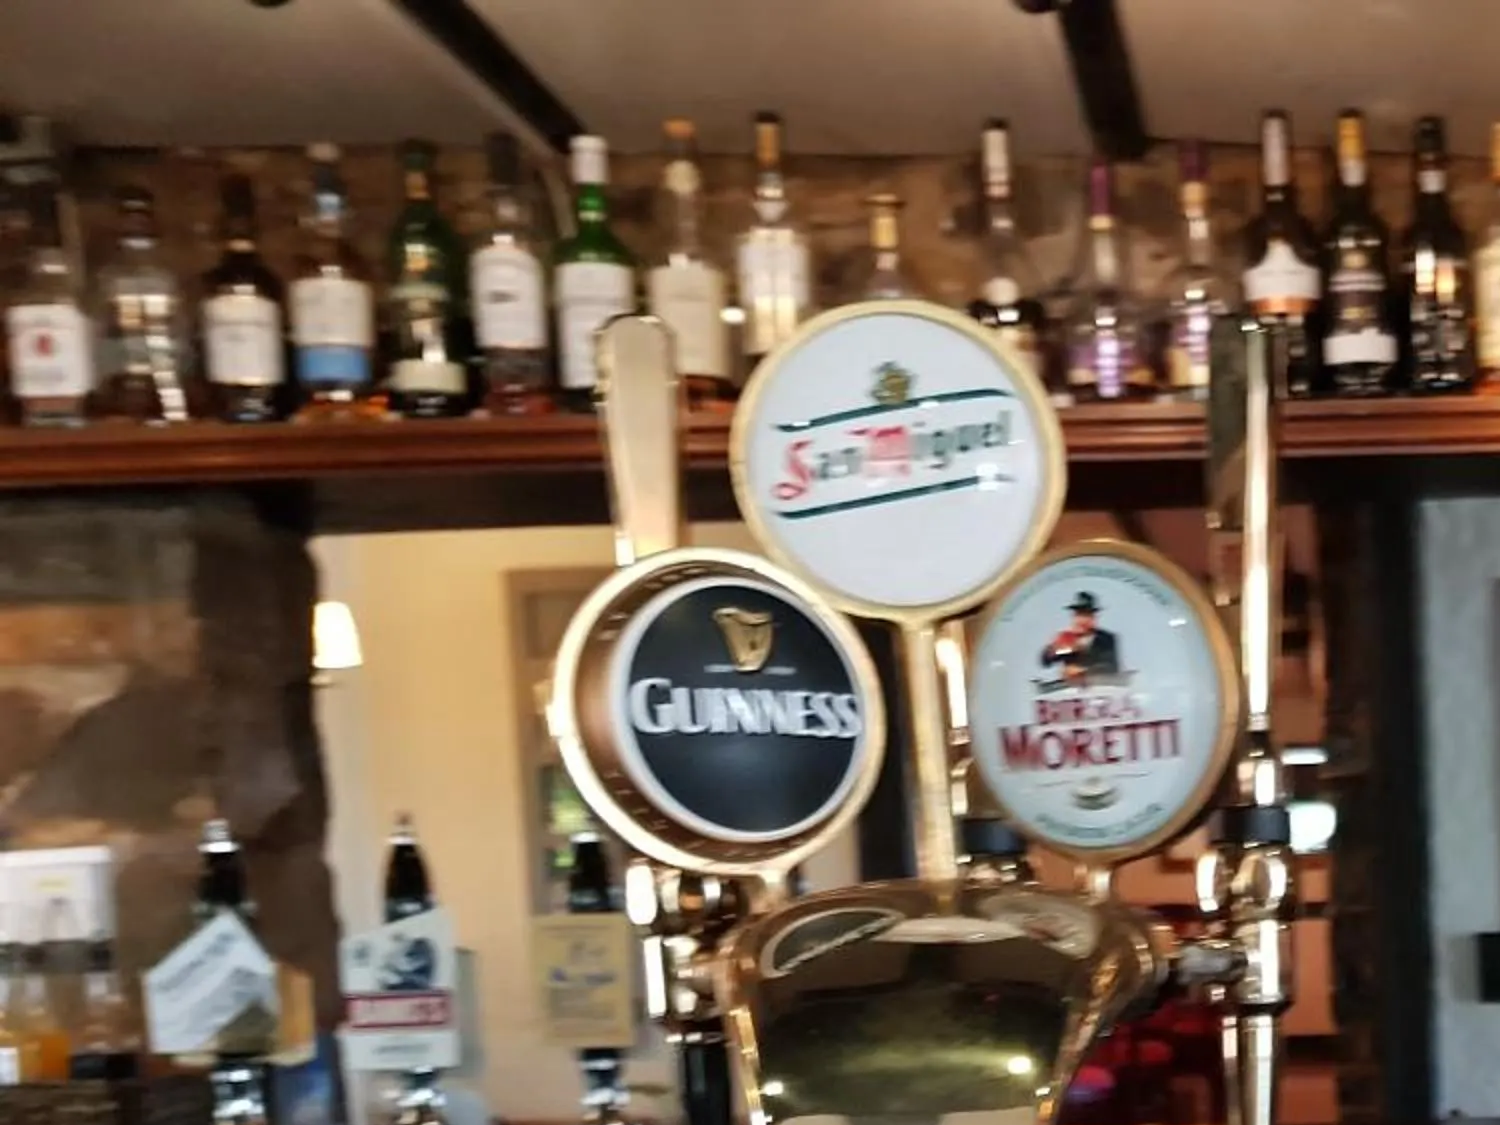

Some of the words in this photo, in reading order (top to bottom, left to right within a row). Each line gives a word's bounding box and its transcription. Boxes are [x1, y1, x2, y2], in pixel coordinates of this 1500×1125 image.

[771, 438, 862, 500] San
[846, 410, 1012, 477] Miguel
[629, 677, 863, 738] GUINNESS
[997, 718, 1182, 774] MORETTI
